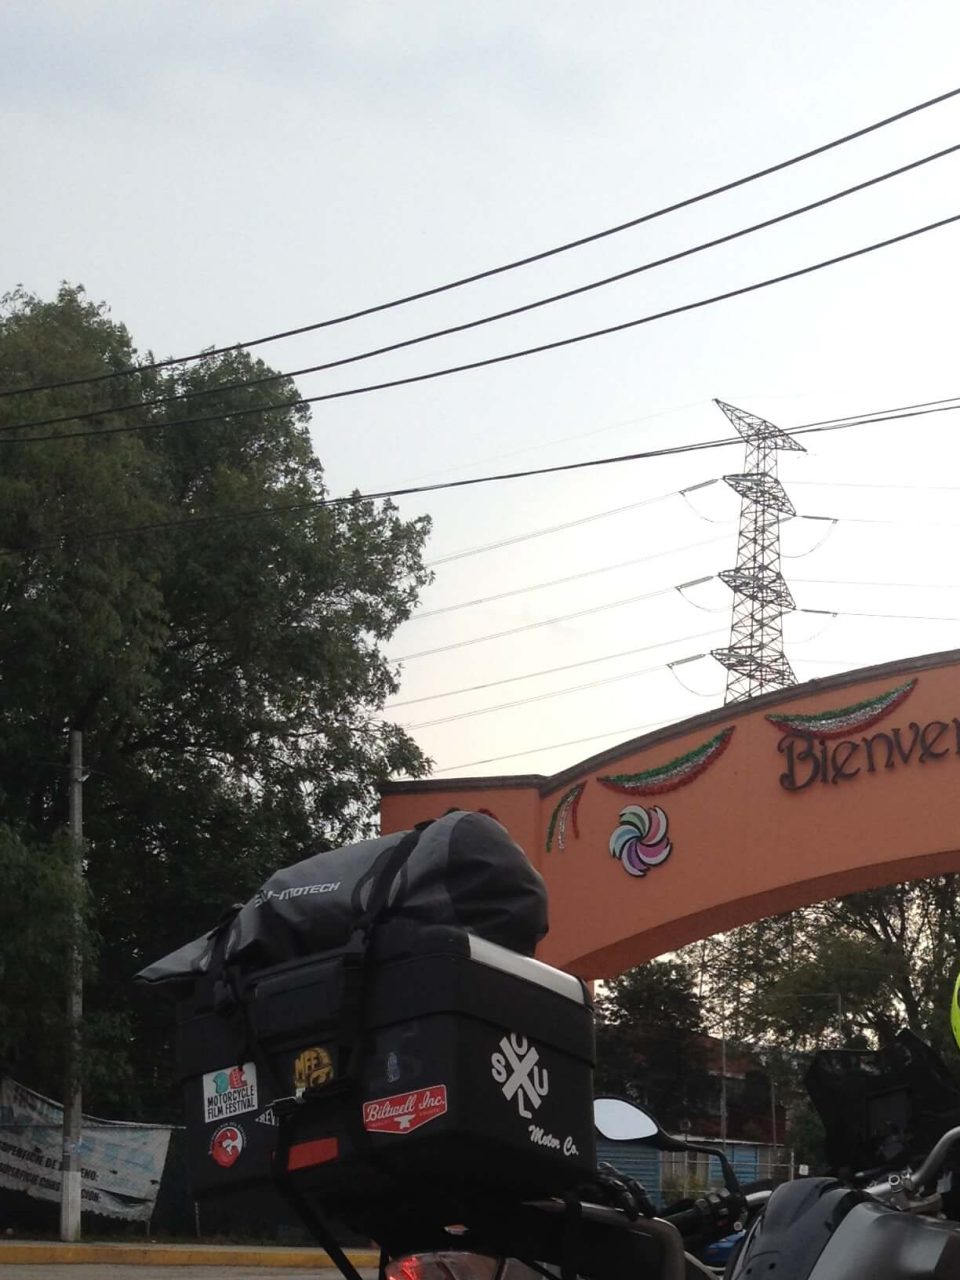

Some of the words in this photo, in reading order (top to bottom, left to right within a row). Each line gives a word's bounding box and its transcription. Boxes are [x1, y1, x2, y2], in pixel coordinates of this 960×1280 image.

[207, 1085, 255, 1107] MOTORCYCLE
[207, 1105, 224, 1120] FILM
[225, 1097, 256, 1115] FESTIVAL
[365, 1094, 417, 1122] Biltwell
[418, 1091, 445, 1109] Inc.
[528, 1124, 561, 1149] Motor
[563, 1136, 579, 1156] Co.
